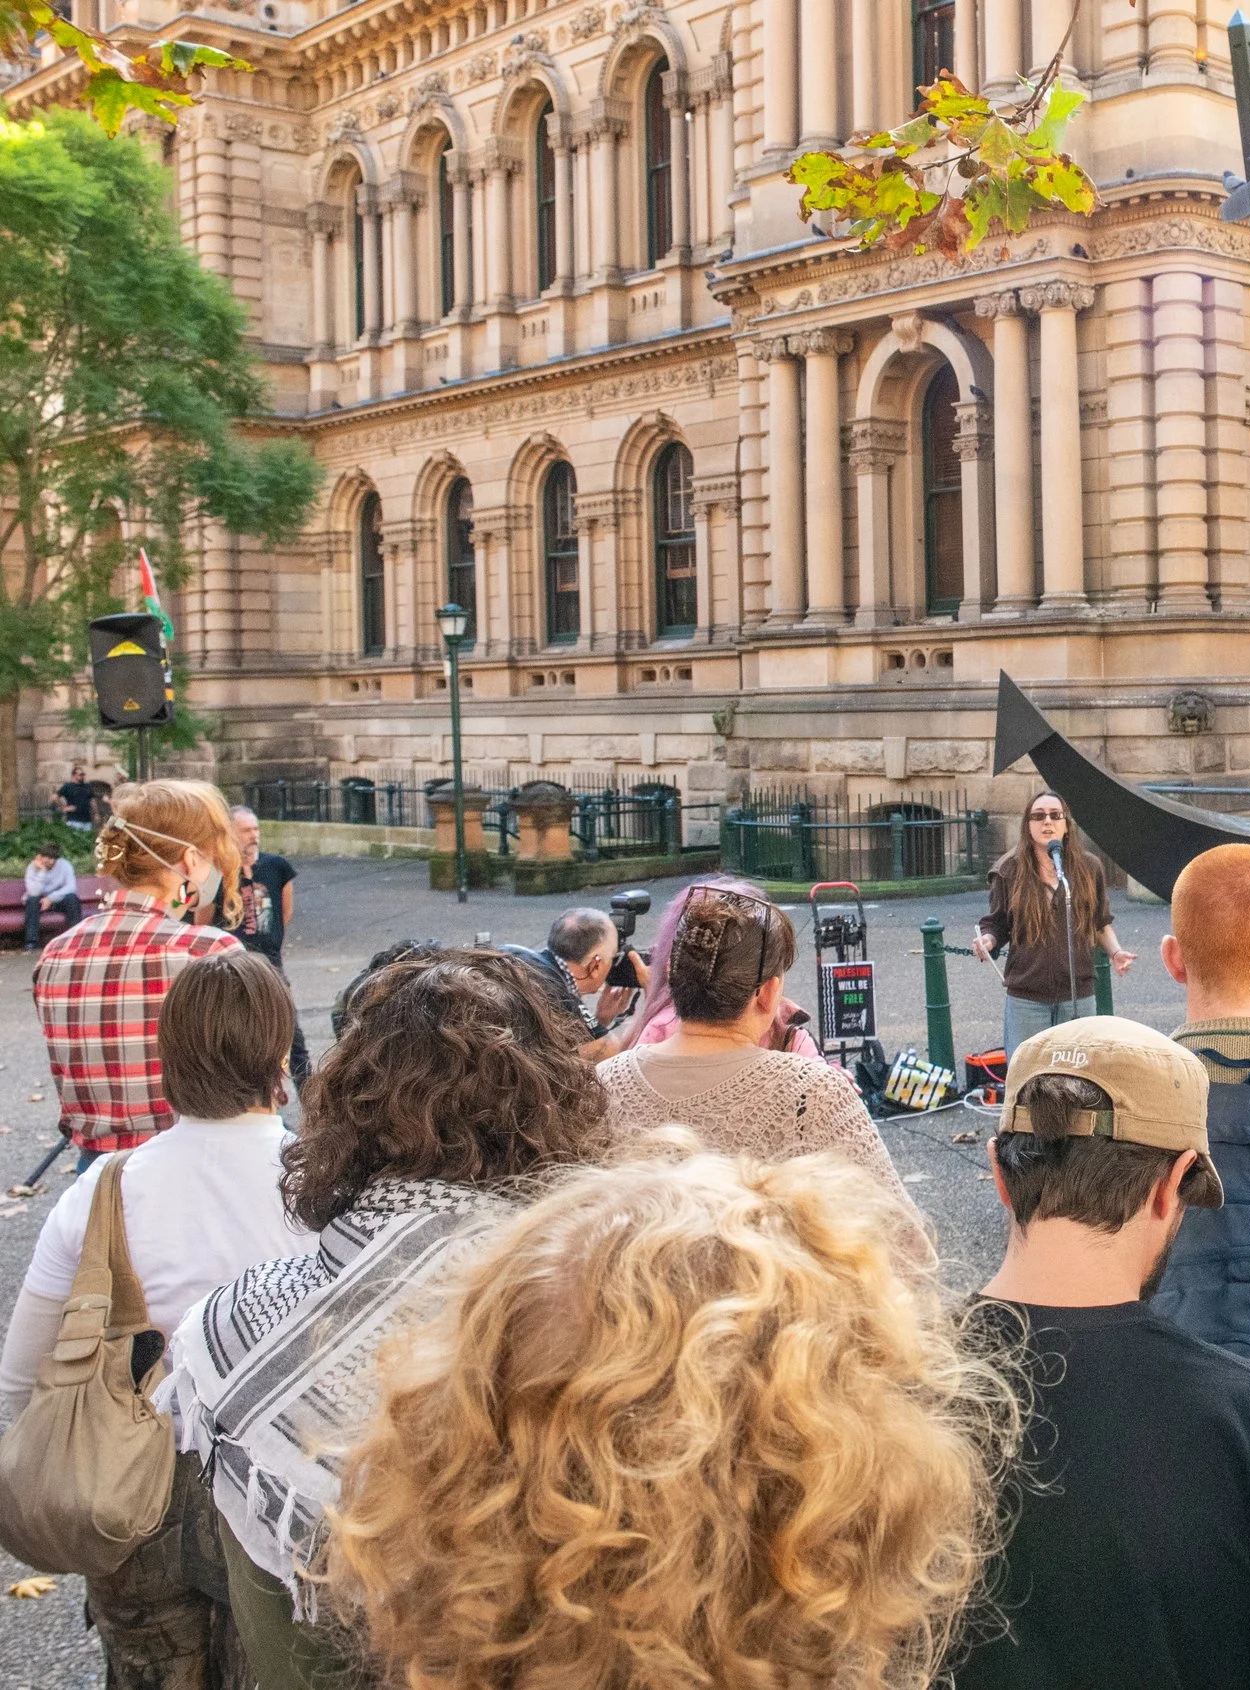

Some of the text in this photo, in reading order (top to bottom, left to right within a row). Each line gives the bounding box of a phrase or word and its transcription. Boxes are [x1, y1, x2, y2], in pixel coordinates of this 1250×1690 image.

[833, 967, 871, 978] PALESTINE
[838, 980, 868, 991] WILL BE
[844, 993, 864, 1004] FREE
